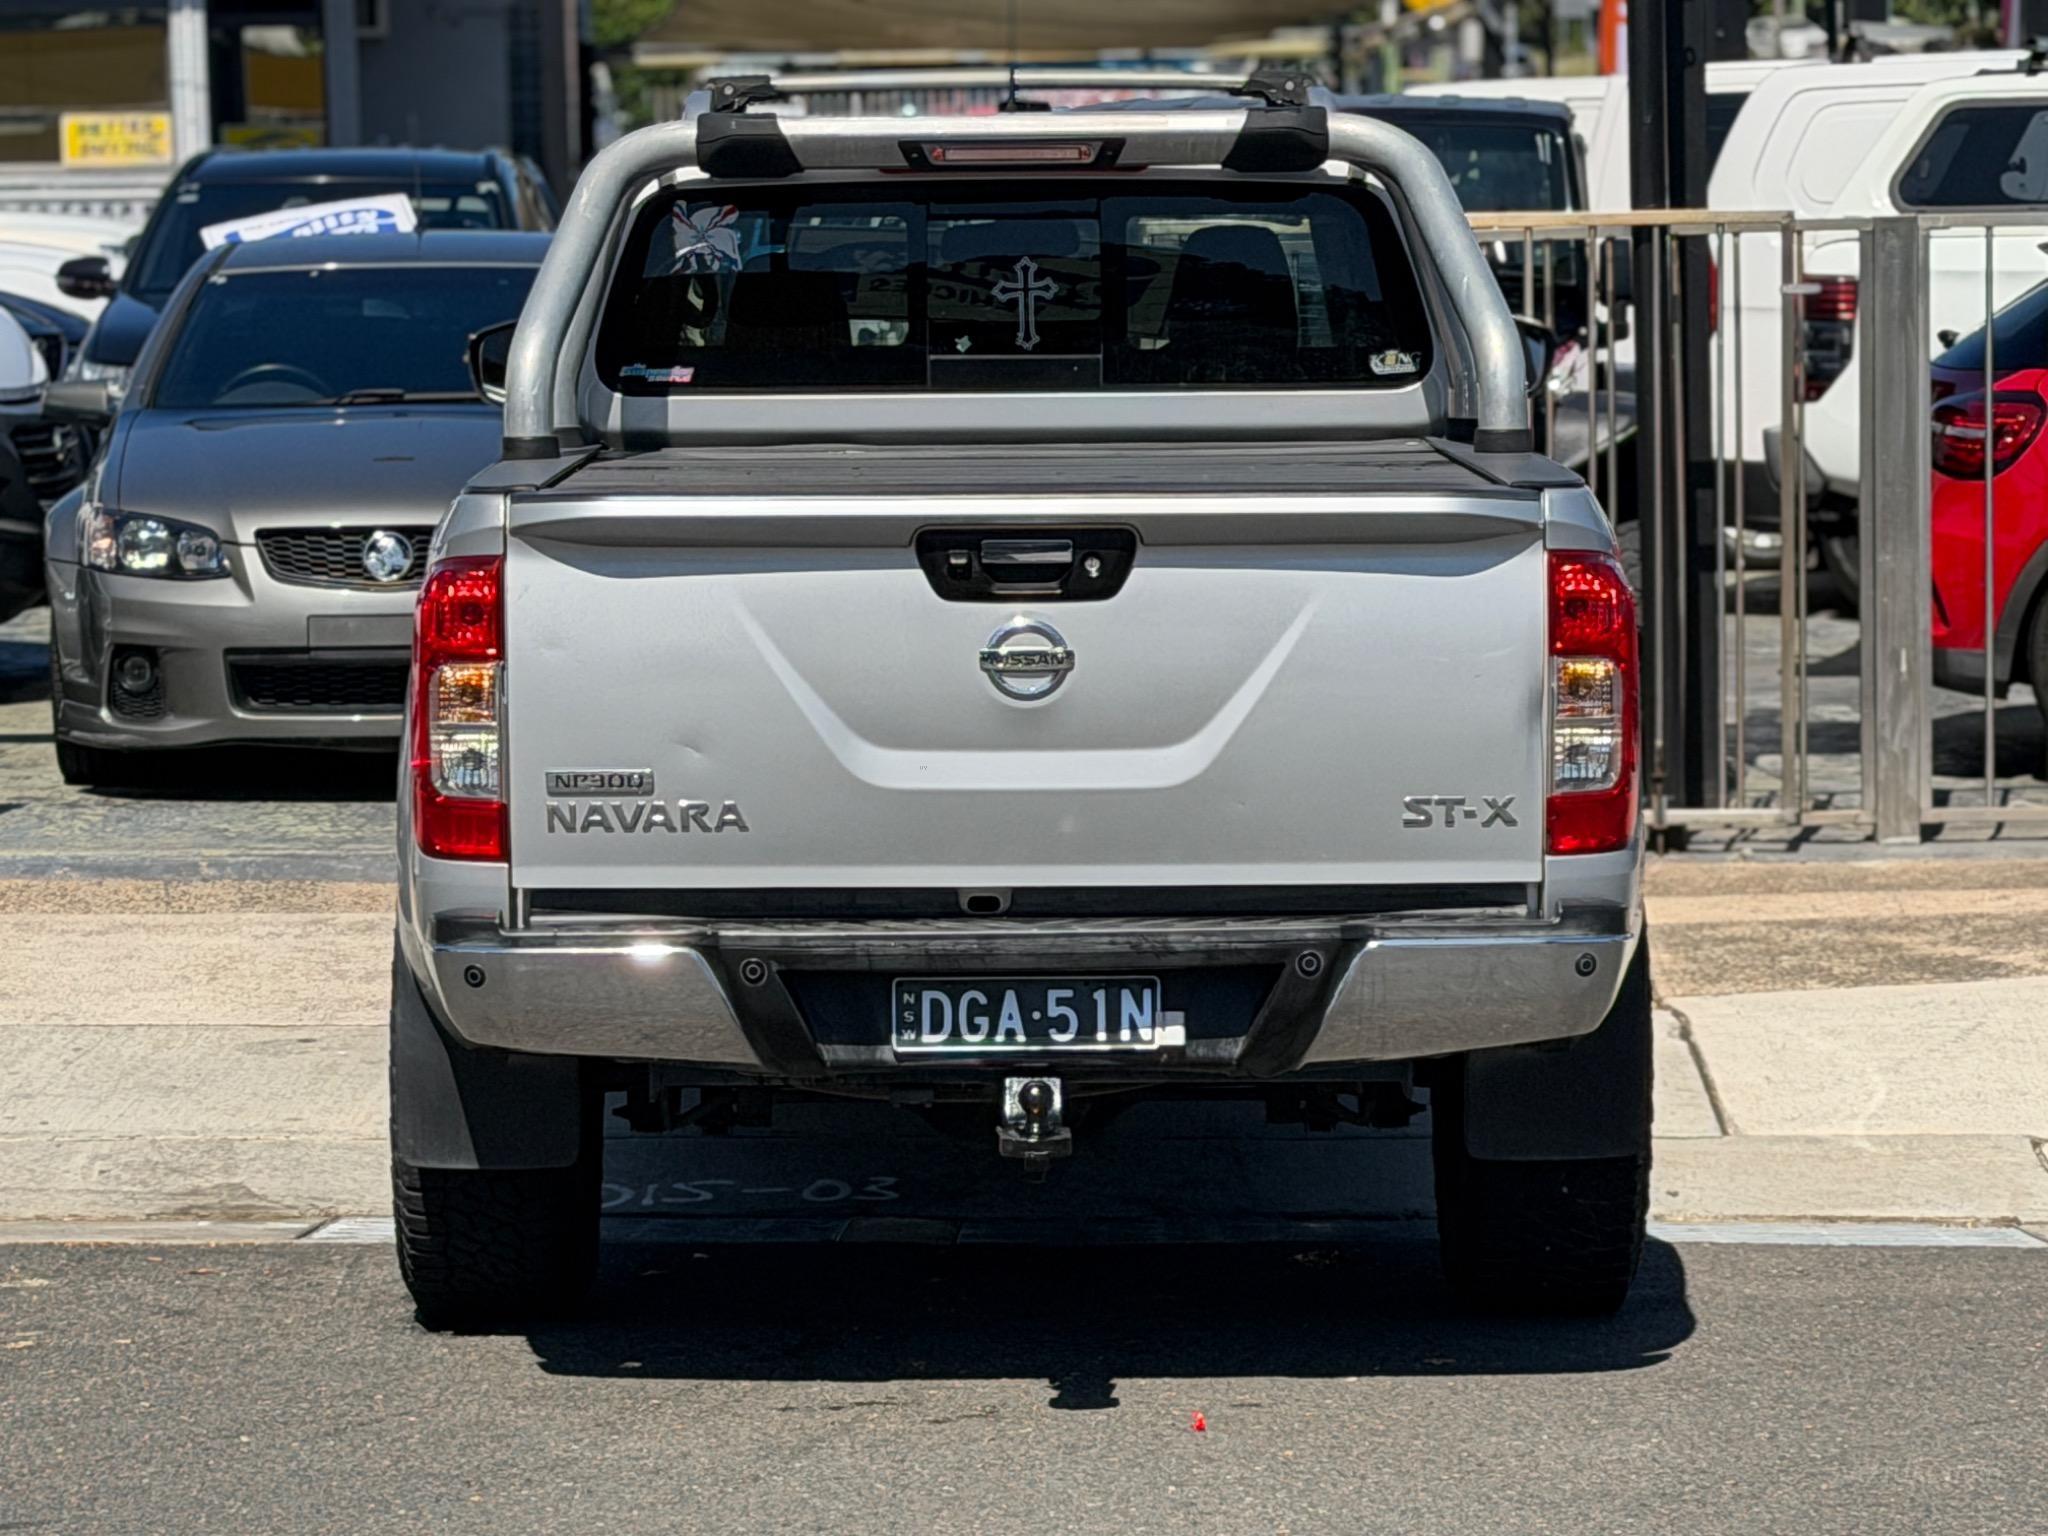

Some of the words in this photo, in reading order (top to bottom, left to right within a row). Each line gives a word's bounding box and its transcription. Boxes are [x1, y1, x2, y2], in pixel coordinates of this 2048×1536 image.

[990, 653, 1066, 666] NISSAN
[555, 773, 644, 789] NP300
[546, 800, 750, 834] NAVARA
[1401, 795, 1519, 828] ST-X
